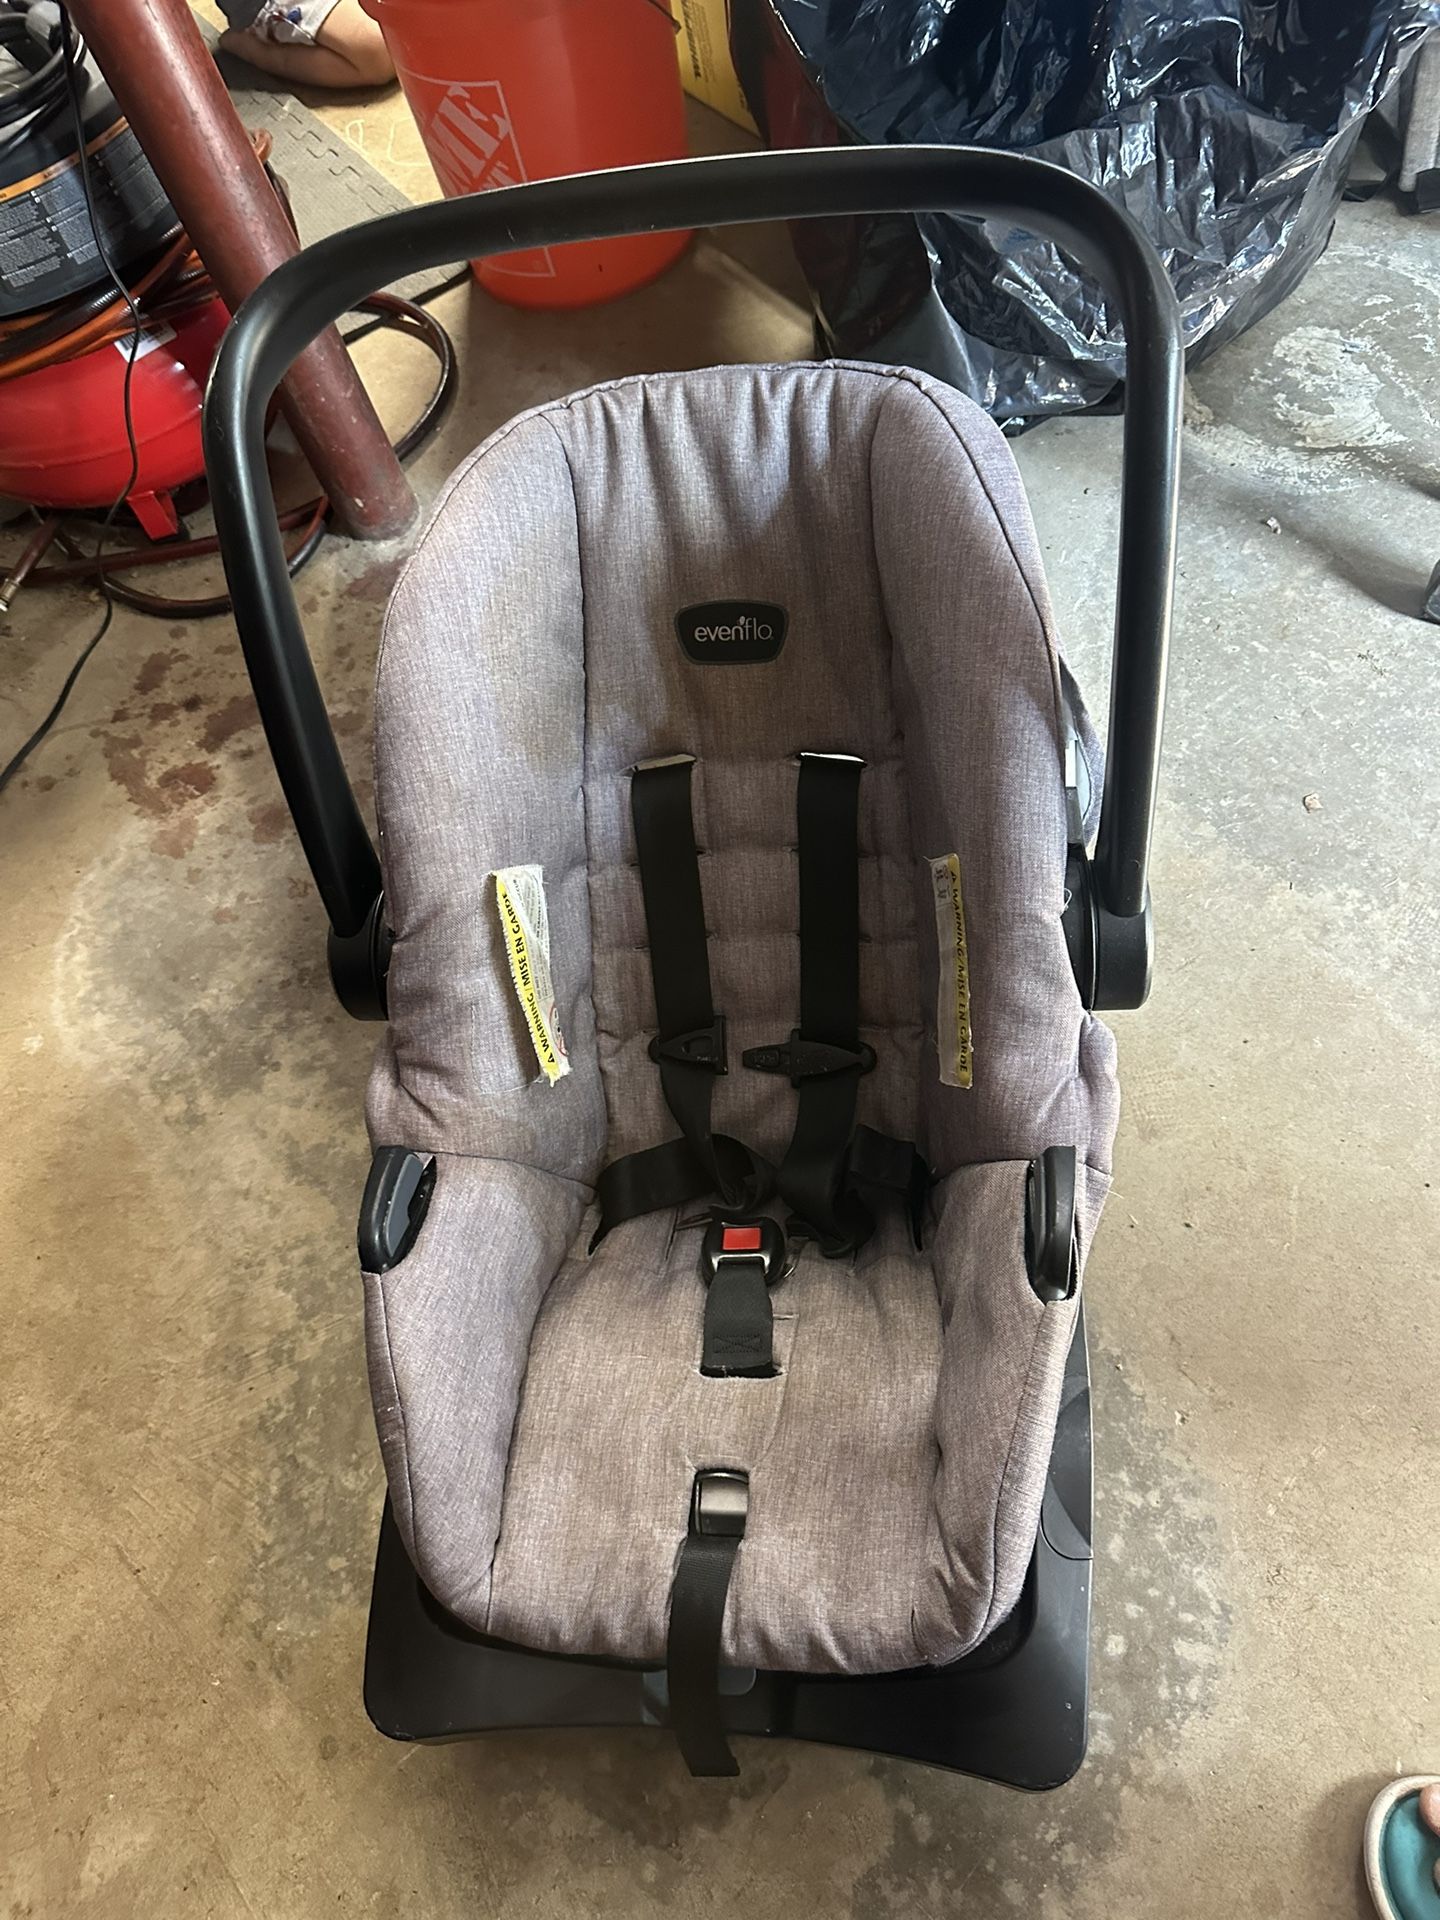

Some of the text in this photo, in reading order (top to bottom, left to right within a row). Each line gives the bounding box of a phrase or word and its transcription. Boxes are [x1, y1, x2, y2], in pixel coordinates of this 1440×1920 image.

[694, 616, 772, 642] evenflo
[515, 937, 525, 954] EN
[958, 1003, 966, 1021] EN
[960, 1026, 968, 1072] GARDE
